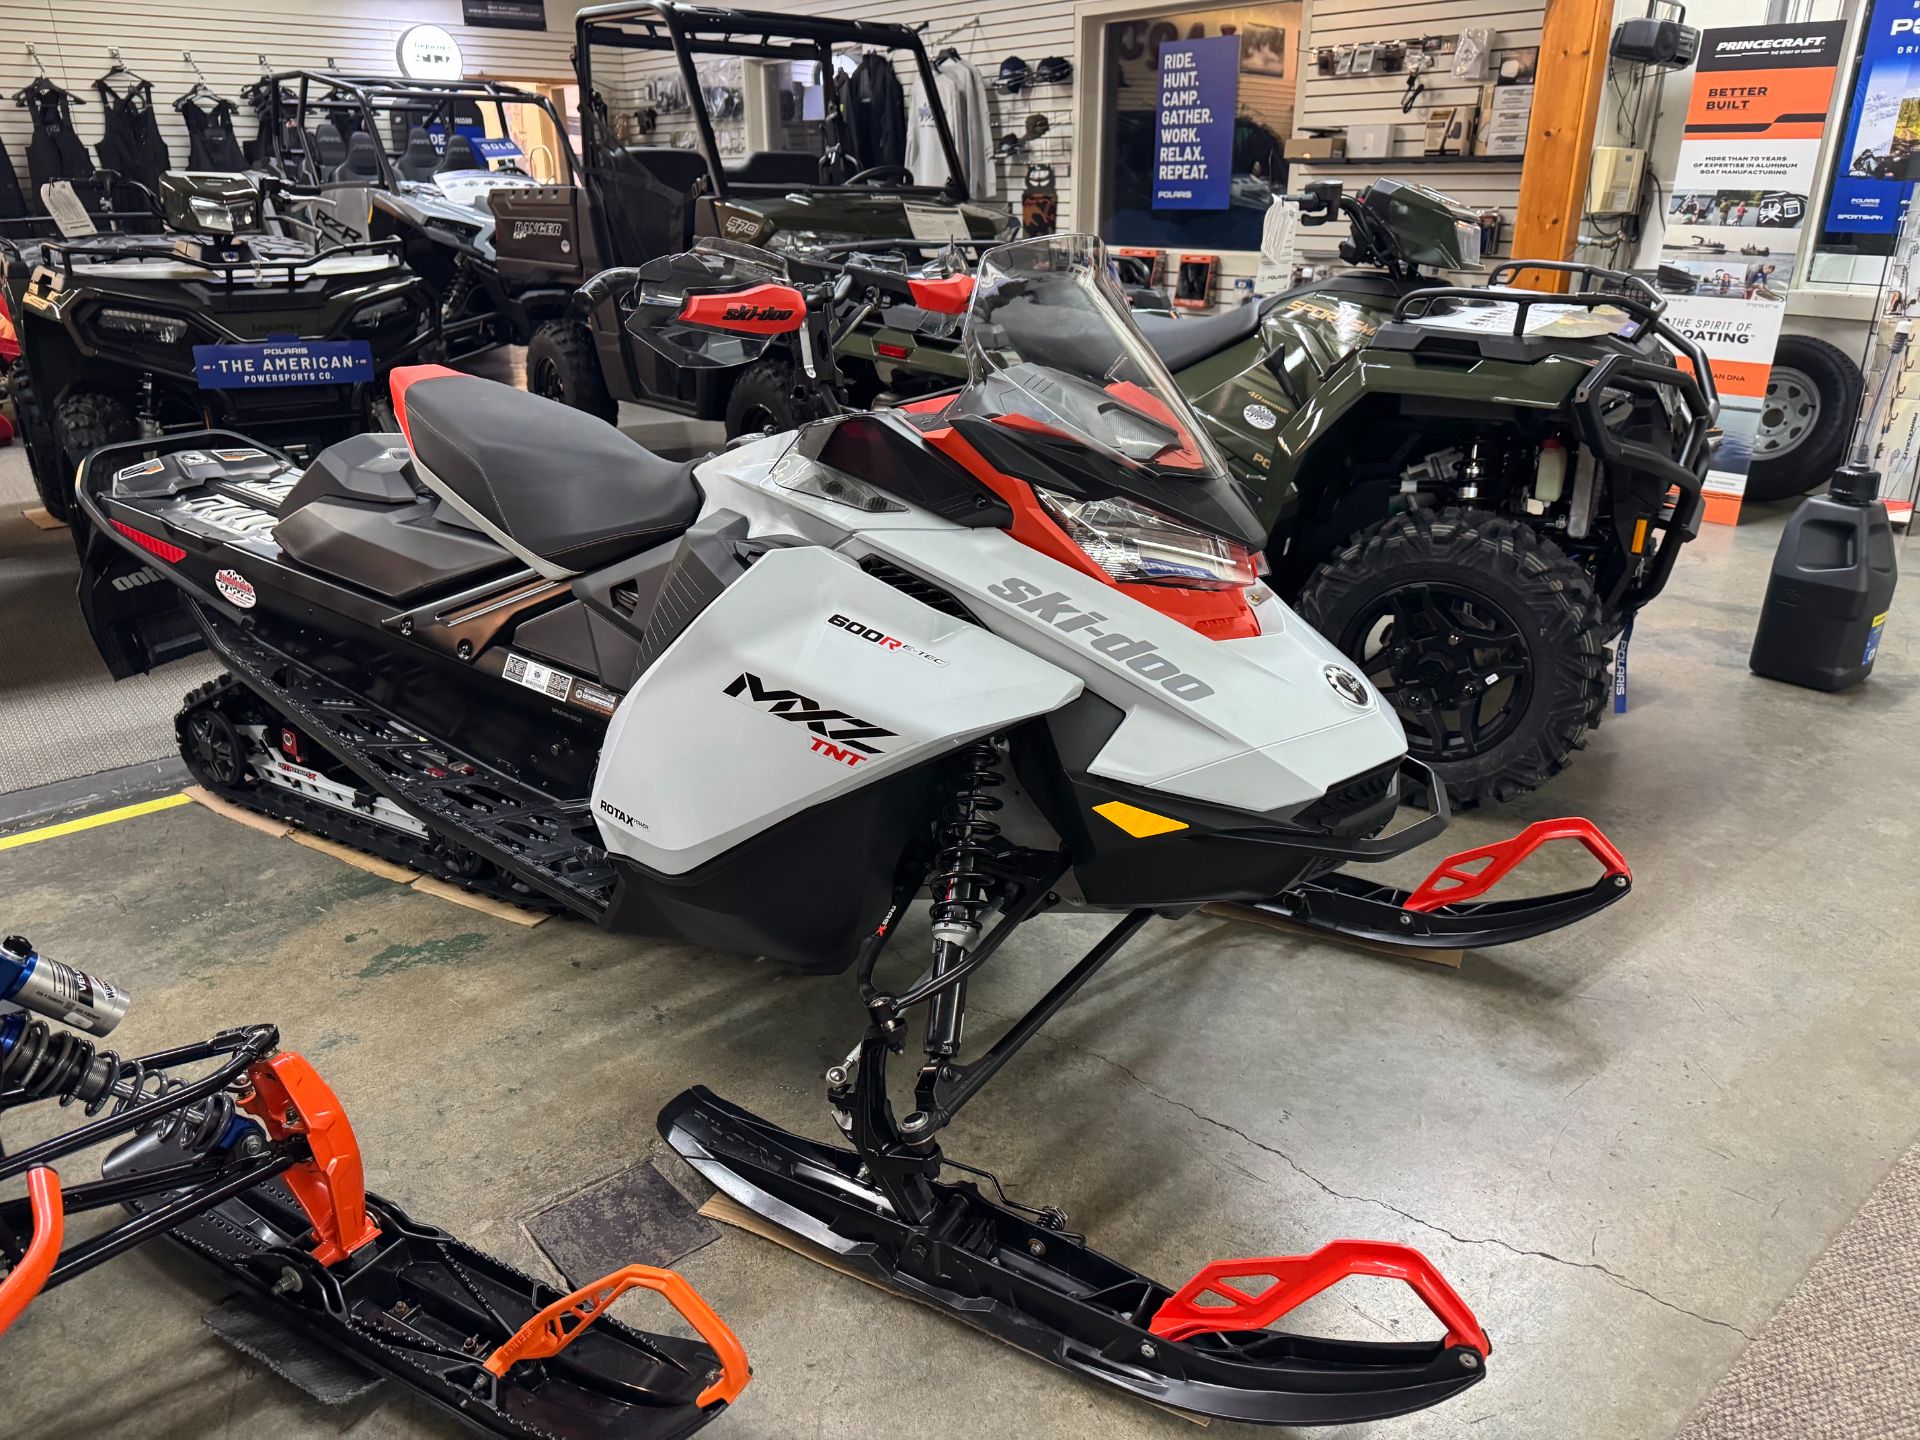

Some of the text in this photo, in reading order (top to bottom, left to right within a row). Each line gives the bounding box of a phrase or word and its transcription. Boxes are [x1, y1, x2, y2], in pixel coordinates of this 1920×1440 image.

[1715, 36, 1827, 51] PRINCECRAFT
[1164, 52, 1196, 70] RIDE.
[1163, 71, 1199, 88] HUNT.
[1162, 90, 1201, 107] CAMP.
[1708, 86, 1768, 97] BETTER
[1706, 100, 1750, 110] BUILT
[1161, 108, 1214, 125] GATHER.
[1161, 128, 1201, 144] WORK.
[481, 142, 516, 150] SOLD
[1160, 146, 1205, 162] RELAX.
[1159, 164, 1209, 180] REPEAT.
[1157, 190, 1193, 199] POLARIS
[514, 221, 562, 236] RANGER
[726, 216, 759, 236] 570
[722, 305, 794, 321] ski-doo
[1671, 317, 1752, 333] THE SPIRIT OF
[1679, 329, 1750, 344] OATING
[263, 347, 308, 356] POLARIS
[218, 355, 353, 373] THE AMERICAN
[244, 372, 335, 383] POWERSPORTS CO.
[987, 577, 1216, 702] ski-doo
[902, 644, 947, 665] E-TEC
[1616, 640, 1627, 696] POLARIS
[722, 671, 902, 755] MXZ
[810, 735, 867, 767] TNT
[600, 799, 634, 828] ROTAX
